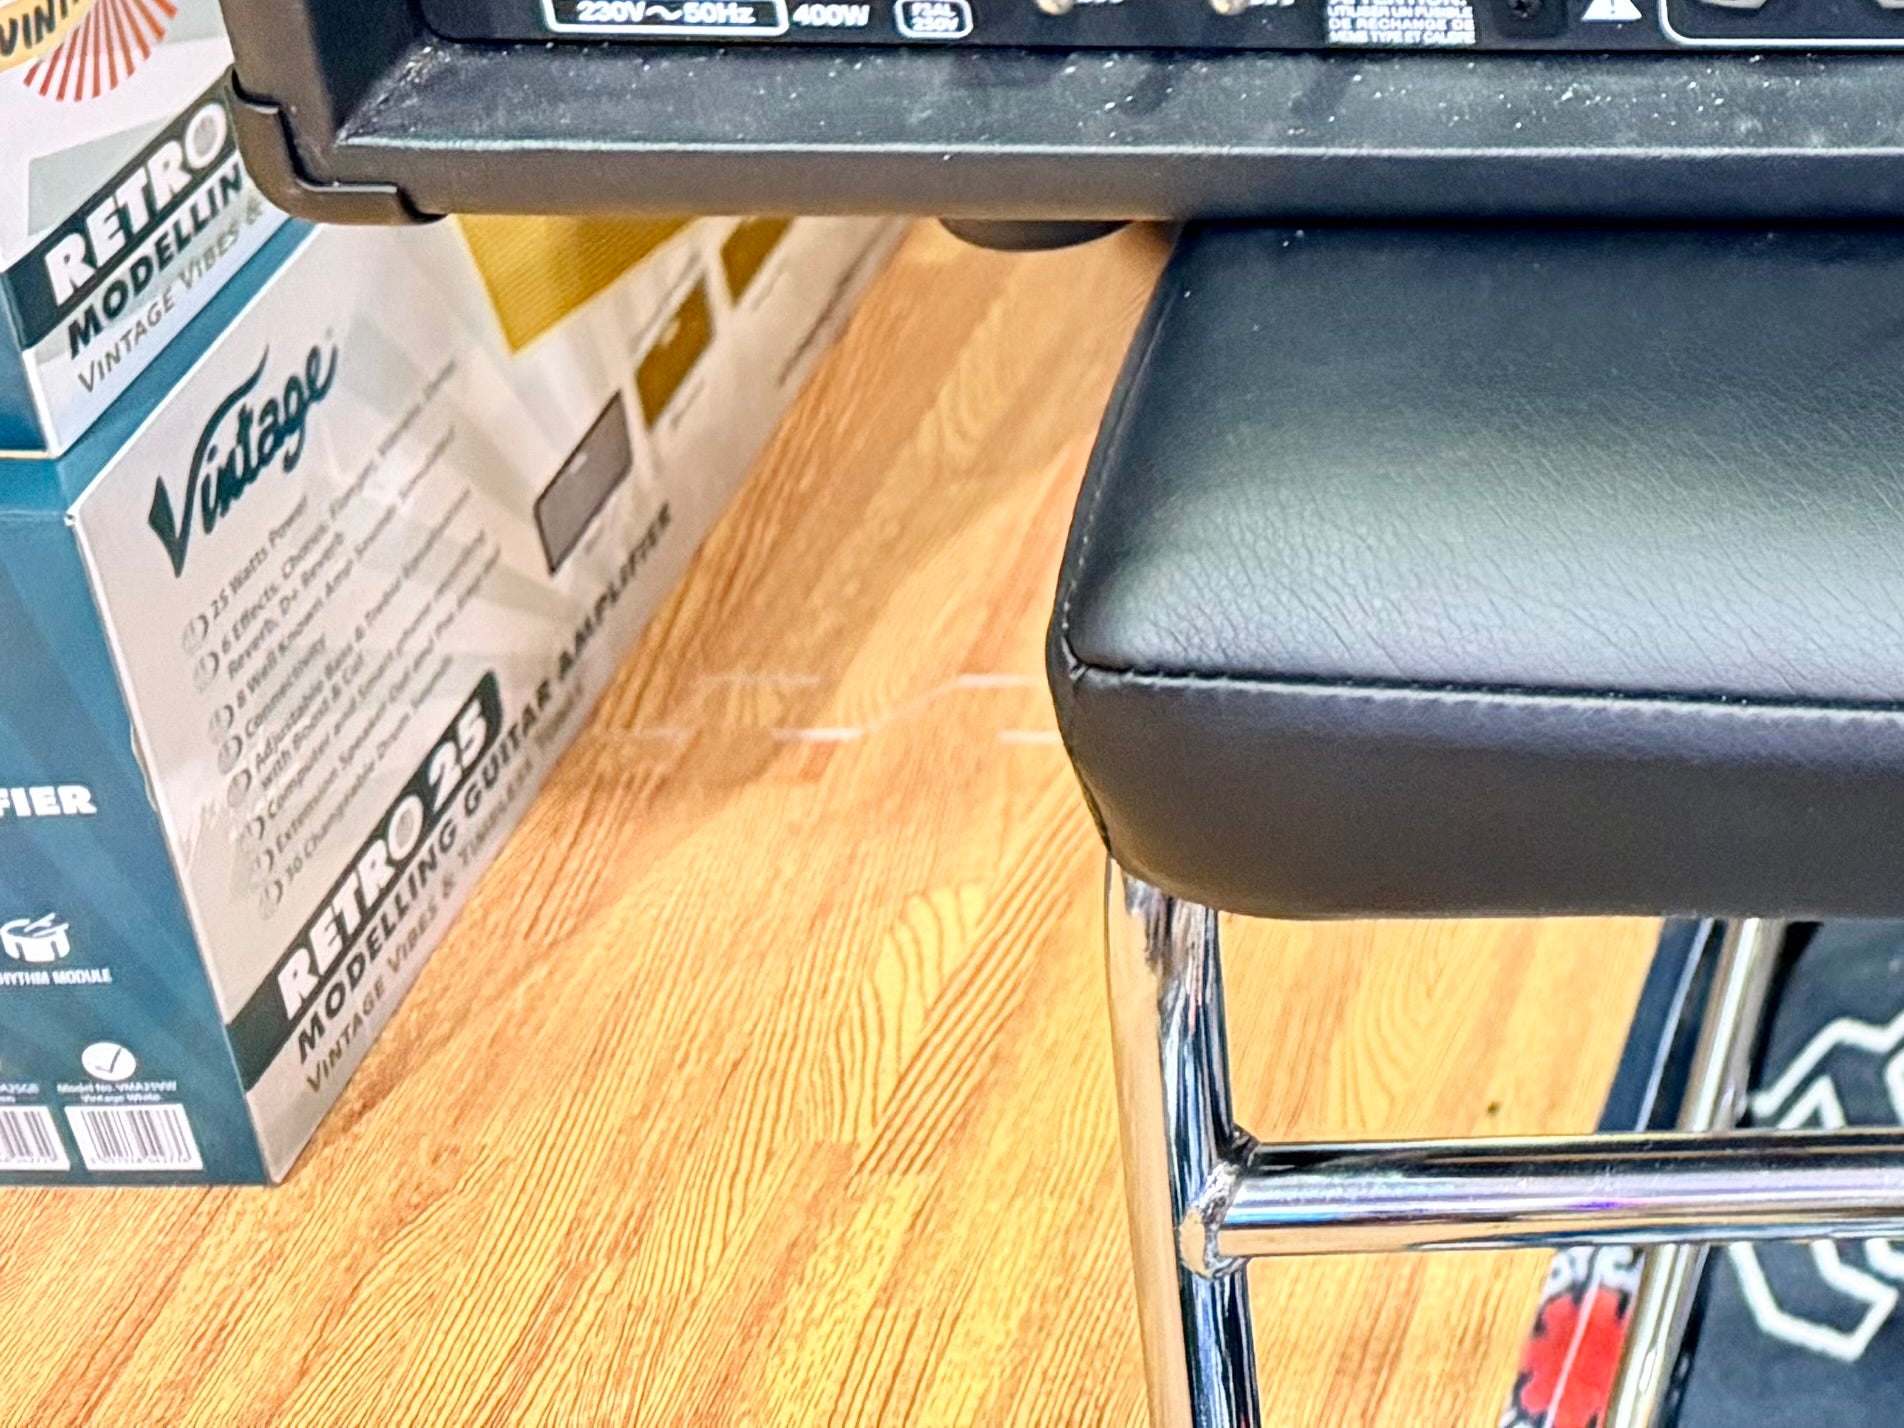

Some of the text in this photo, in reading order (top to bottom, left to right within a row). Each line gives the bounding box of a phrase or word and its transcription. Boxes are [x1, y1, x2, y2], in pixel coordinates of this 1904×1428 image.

[793, 3, 870, 27] 400W
[44, 102, 227, 307] RETRO
[78, 224, 240, 394] VINTAGE VIBES
[148, 343, 338, 579] Vintage
[230, 547, 270, 596] Watts
[277, 698, 488, 1019] RETRO 25
[298, 500, 671, 1063] MODELLING GUITAR AMPLIFIER
[52, 968, 112, 984] MODULE
[305, 979, 386, 1094] VINTAGE
